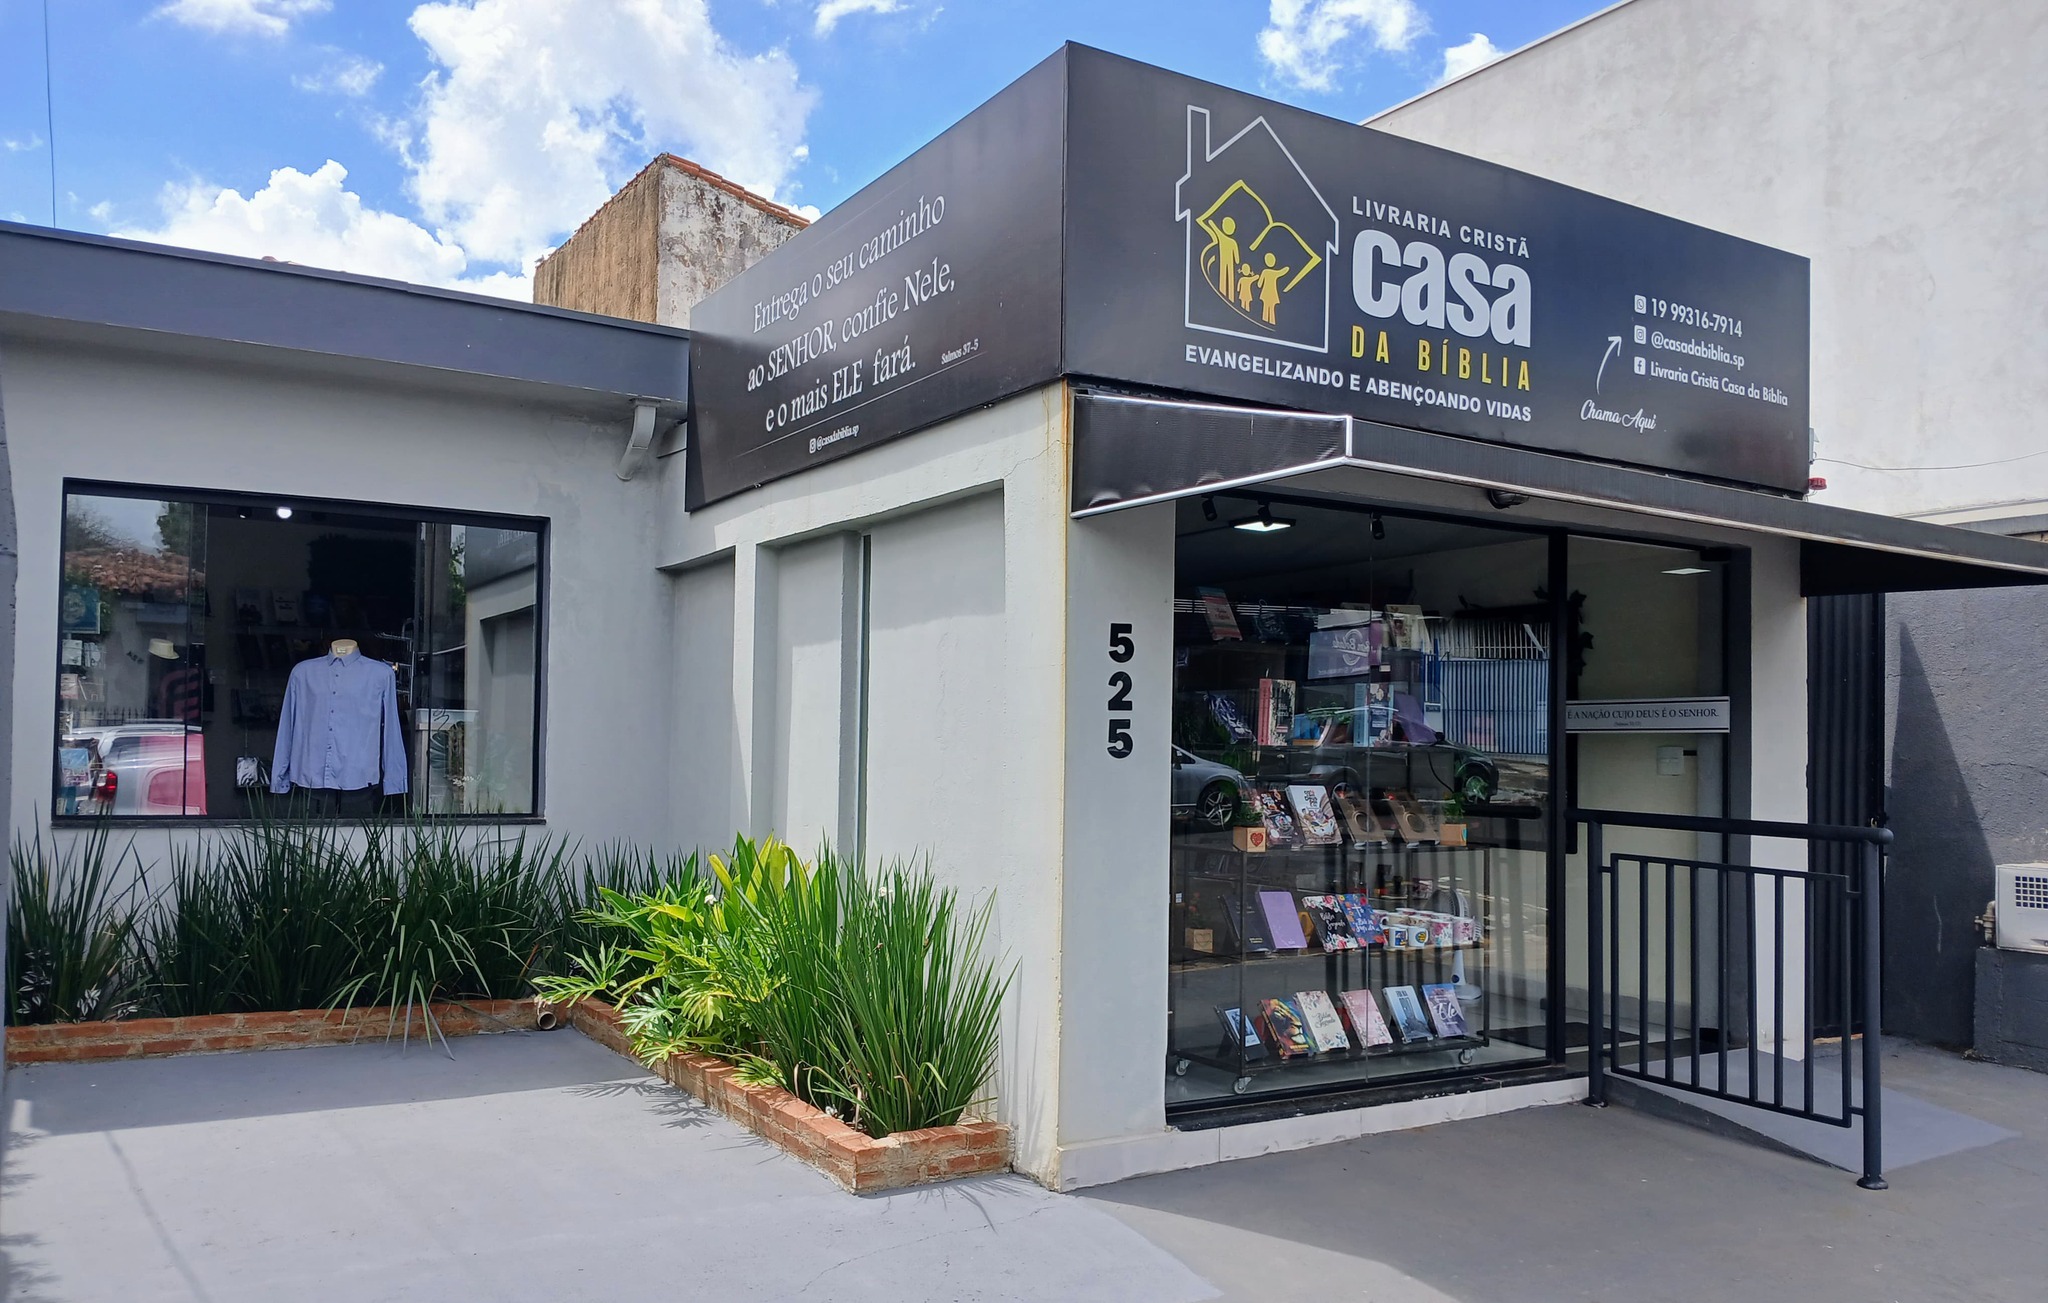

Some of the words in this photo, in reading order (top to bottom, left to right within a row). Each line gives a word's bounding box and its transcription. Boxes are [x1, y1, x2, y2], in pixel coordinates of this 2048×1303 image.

[1352, 196, 1451, 239] LIVRARIA
[1459, 225, 1530, 259] CRISTÃ
[753, 282, 809, 334] Entrega
[811, 272, 822, 299] o
[826, 253, 855, 290] seu
[859, 194, 946, 270] caminho
[1352, 229, 1532, 348] casa
[747, 364, 764, 393] ao
[767, 318, 837, 382] SENHOR,
[841, 289, 899, 343] confie
[903, 256, 956, 312] Nele,
[1651, 298, 1667, 318] 19
[1670, 302, 1743, 338] 99316-7914
[766, 408, 775, 432] e
[777, 403, 788, 427] o
[790, 378, 828, 421] mais
[832, 358, 864, 404] ELE
[872, 334, 917, 386] fará.
[1185, 344, 1344, 388] EVANGELIZANDO
[1350, 374, 1361, 391] E
[1365, 377, 1482, 414] ABENÇOANDO
[1486, 399, 1532, 422] VIDAS
[1352, 325, 1390, 364] DA
[1418, 338, 1531, 391] BÍBLIA
[1650, 361, 1689, 384] Livraria
[1690, 370, 1719, 391] Cristã
[1721, 377, 1746, 396] Casa
[1747, 382, 1761, 400] da
[1651, 331, 1745, 371] @casadabiblia.sp
[1580, 399, 1622, 425] Chama
[1621, 408, 1657, 433] Aqui
[1581, 709, 1611, 720] NAÇÃO
[1612, 710, 1635, 719] CUJO
[1636, 709, 1660, 718] DEUS
[1661, 707, 1667, 718] É
[1668, 709, 1677, 718] O
